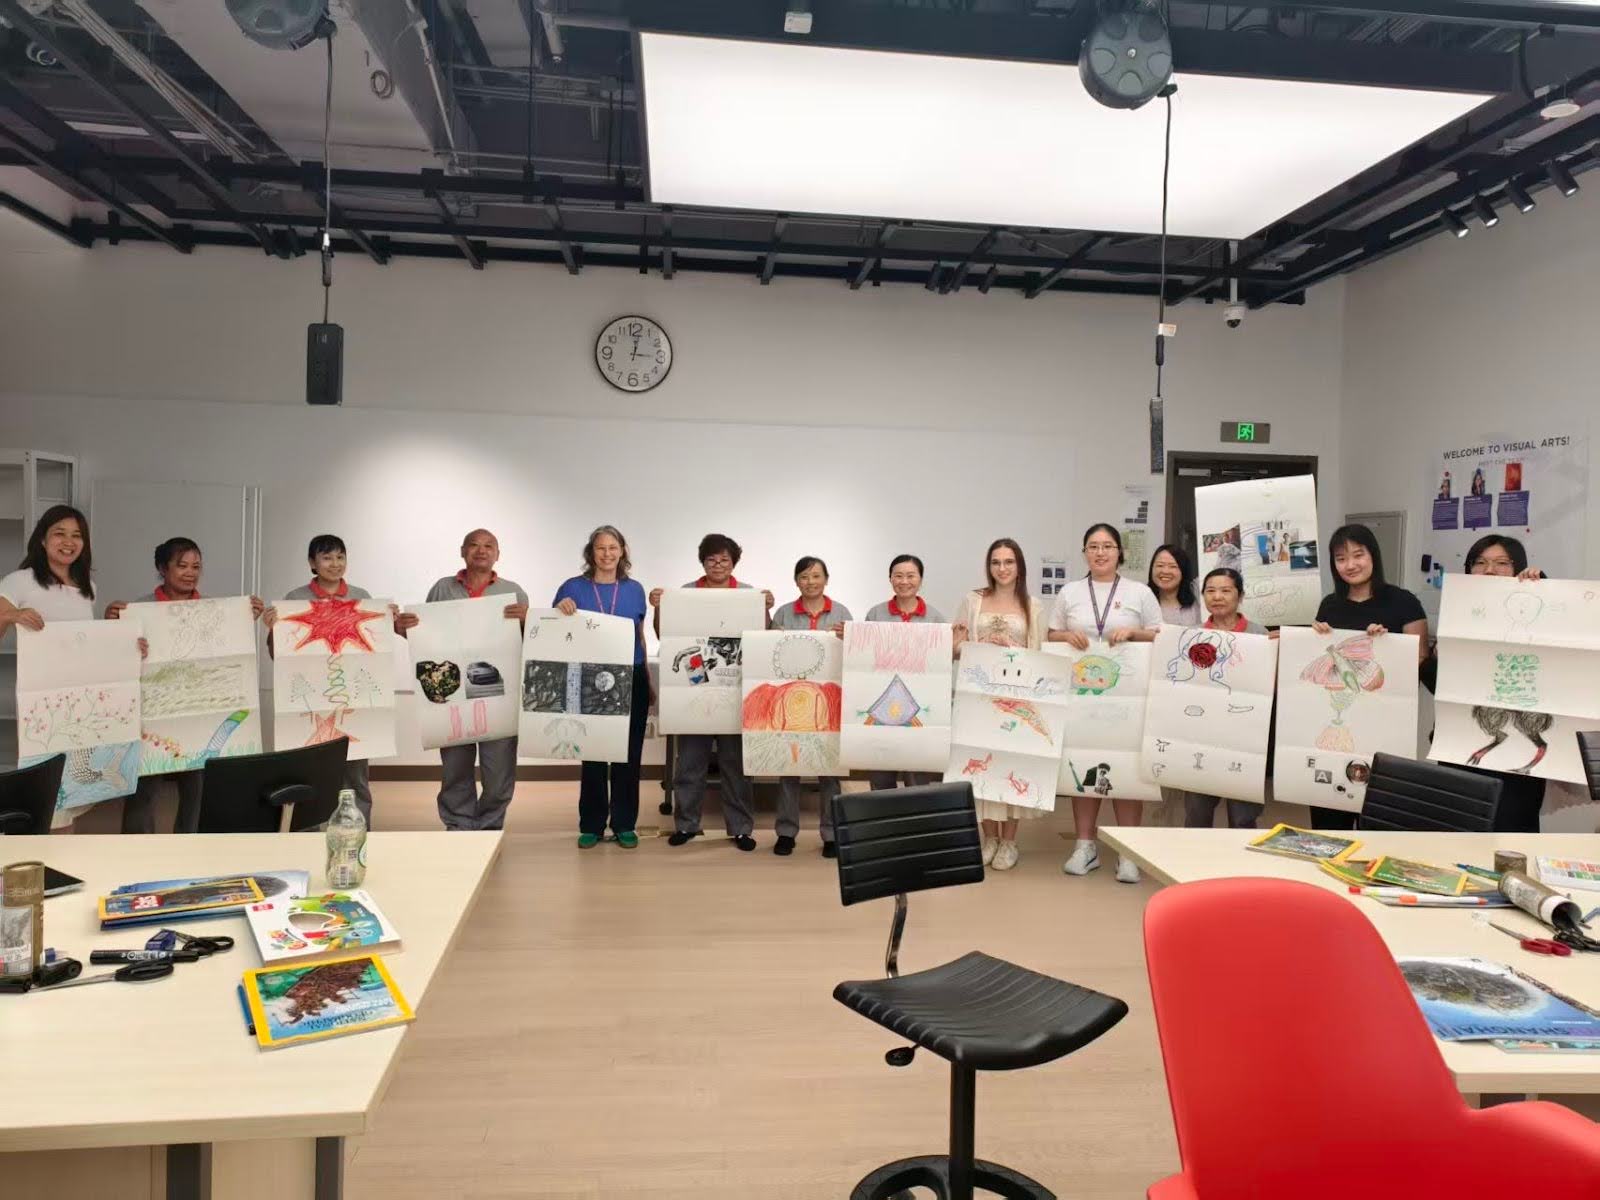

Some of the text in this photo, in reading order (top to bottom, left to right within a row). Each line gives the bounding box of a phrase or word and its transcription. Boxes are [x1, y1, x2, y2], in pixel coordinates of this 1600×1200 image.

[628, 322, 643, 338] 12
[653, 338, 662, 348] 2
[601, 345, 613, 361] 9
[655, 349, 666, 365] 3
[607, 361, 615, 372] 8
[651, 365, 658, 375] 4
[616, 371, 623, 381] 7
[627, 372, 639, 387] 6
[642, 373, 650, 383] 5
[1443, 436, 1571, 460] WELCOME TO VISUAL ARTS!
